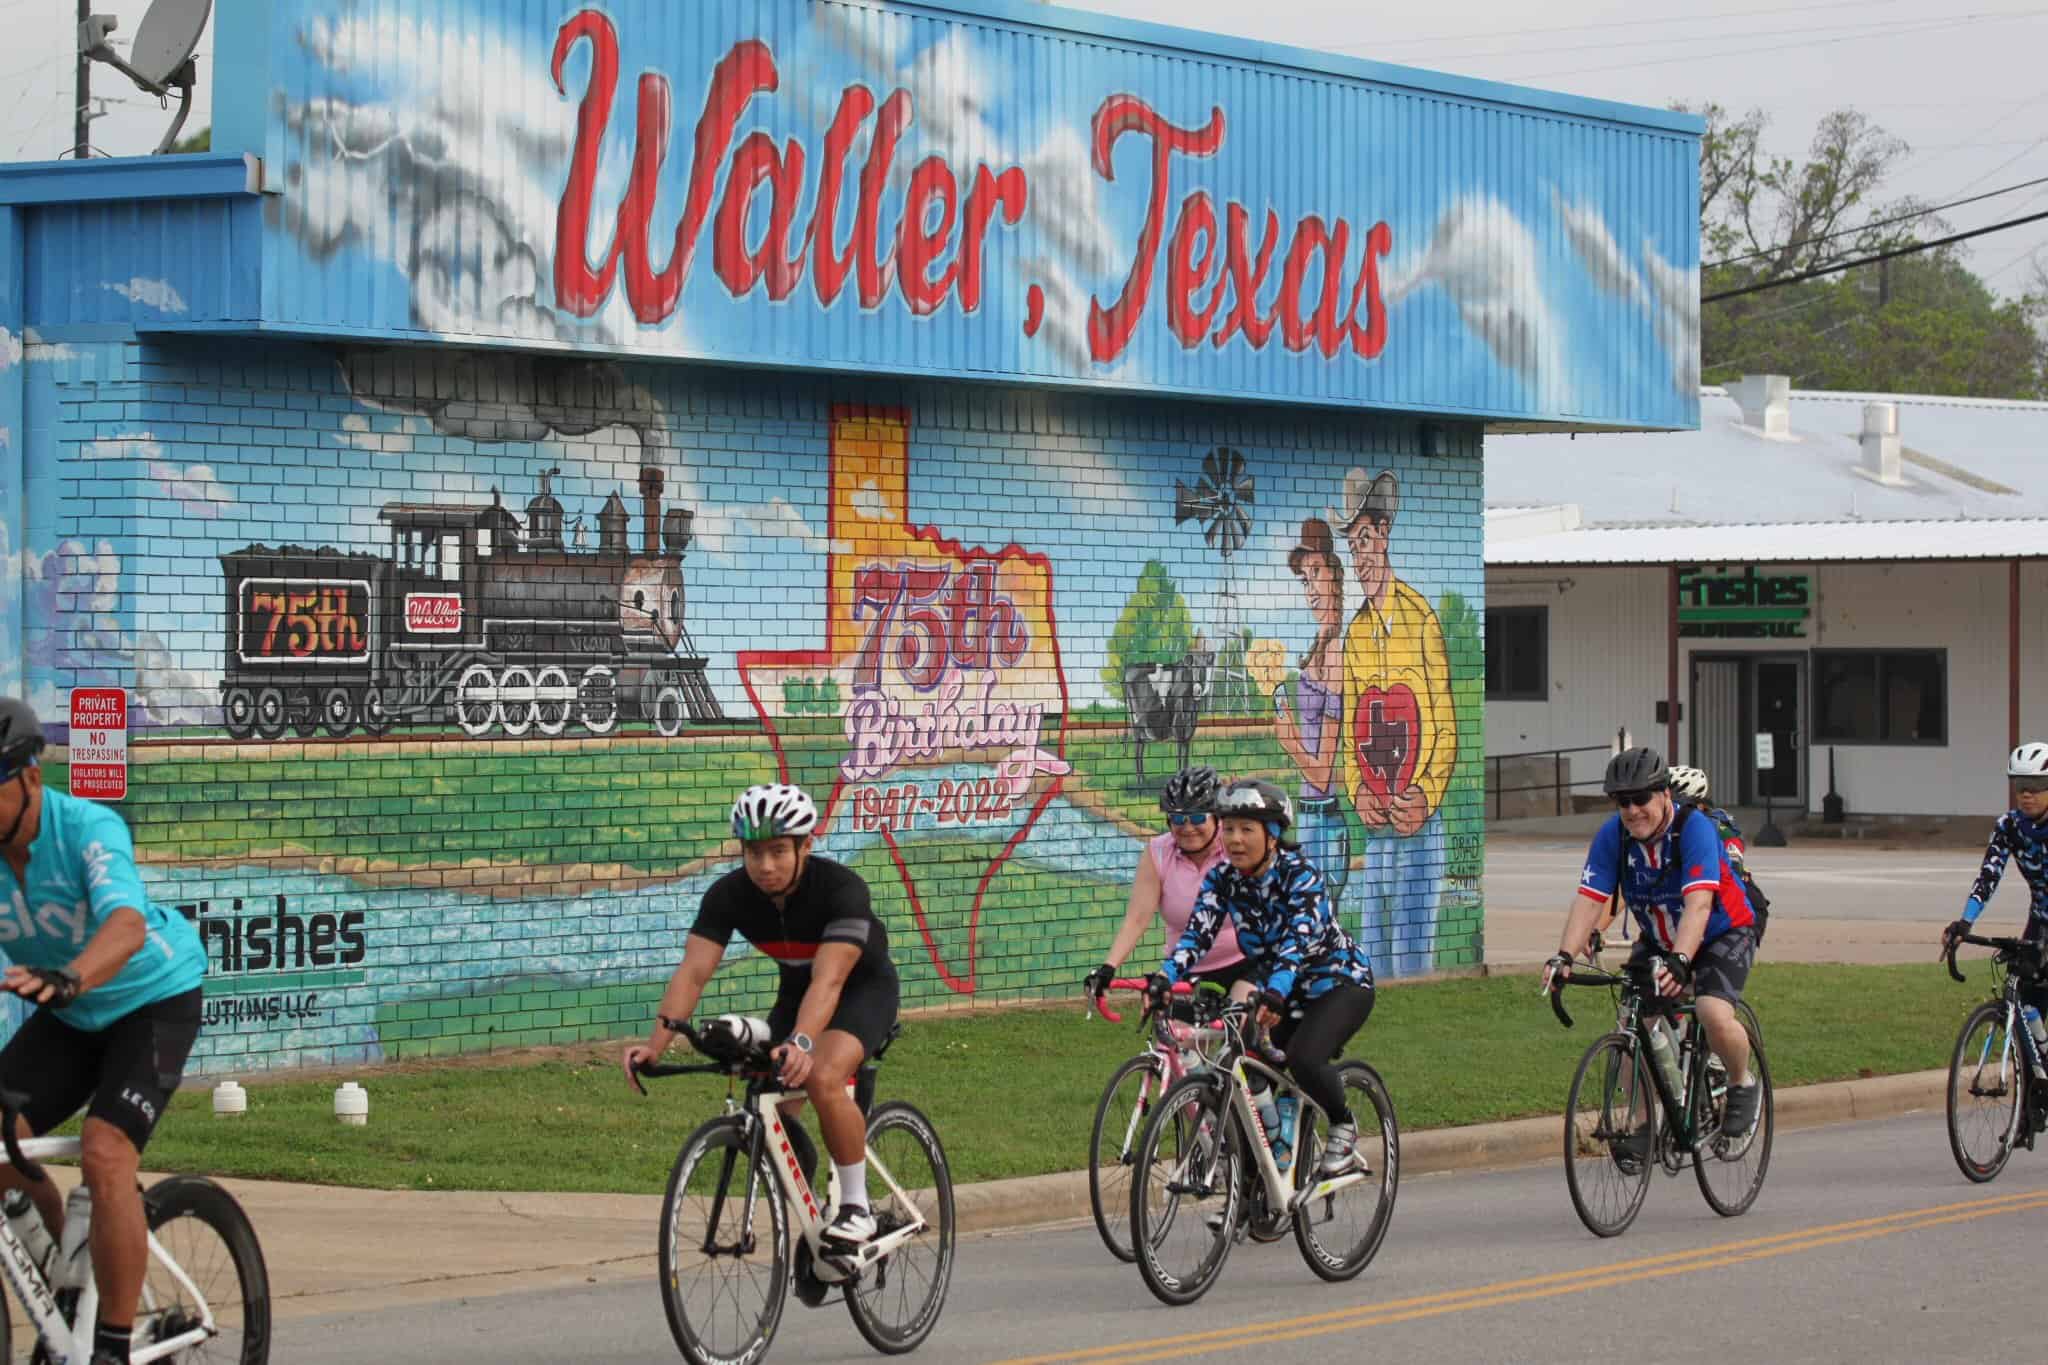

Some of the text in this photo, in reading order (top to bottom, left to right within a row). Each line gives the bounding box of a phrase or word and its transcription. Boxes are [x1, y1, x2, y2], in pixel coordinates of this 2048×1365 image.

[1088, 92, 1392, 364] Texas
[251, 587, 367, 657] 75th
[410, 600, 465, 625] Waller
[853, 560, 1029, 692] 75th
[73, 712, 123, 726] PROPERTY
[78, 697, 118, 711] PRIVATE
[72, 748, 125, 761] TRESPASSING
[89, 731, 107, 746] NO
[840, 668, 1073, 803] Birthday
[73, 767, 123, 778] VIOLATORS WILL
[84, 779, 123, 790] PROSECUTED
[0, 889, 88, 945] sky
[176, 894, 365, 972] inishes
[772, 1119, 818, 1223] TREK
